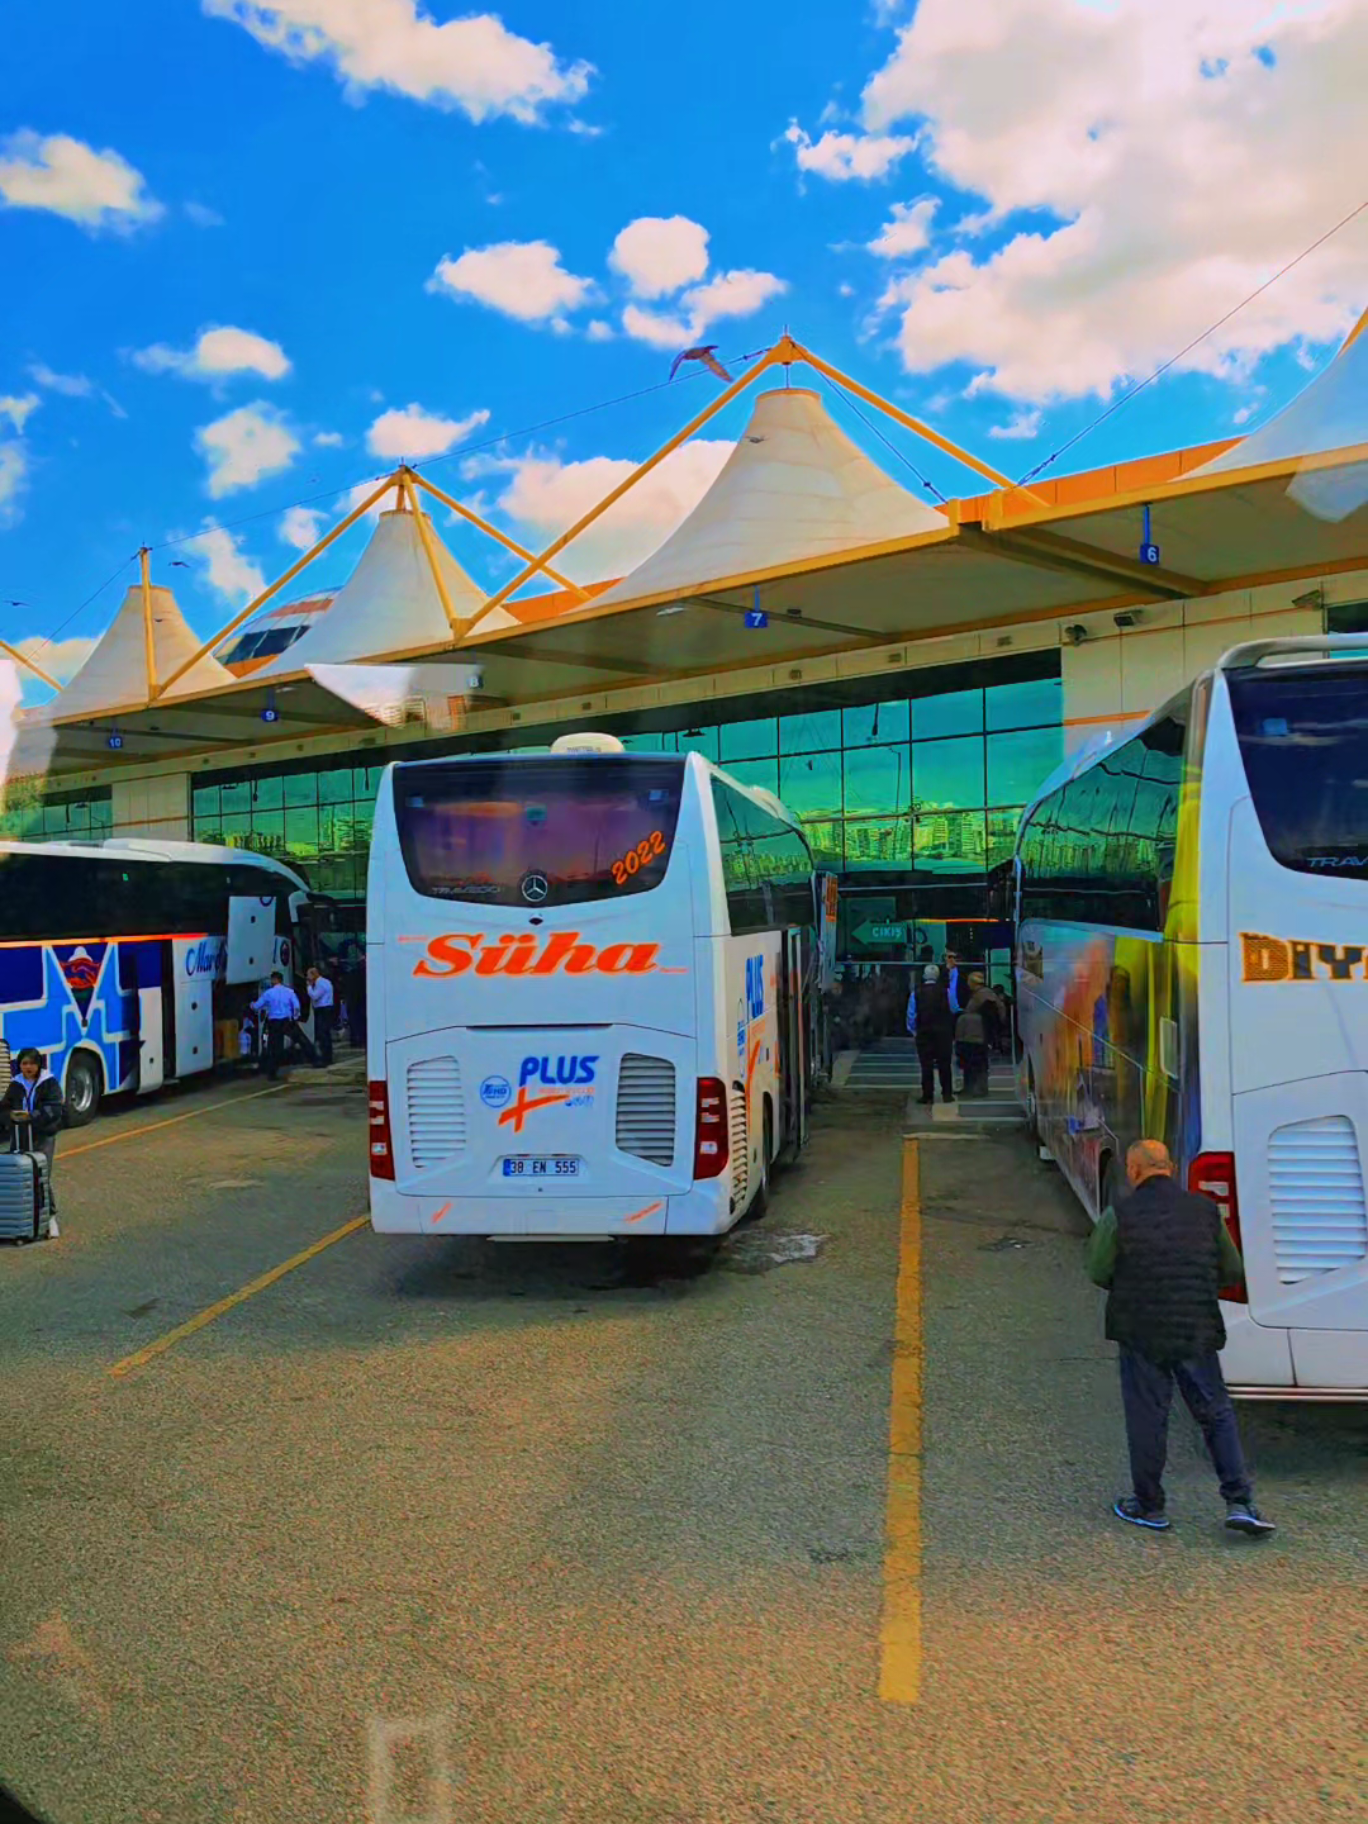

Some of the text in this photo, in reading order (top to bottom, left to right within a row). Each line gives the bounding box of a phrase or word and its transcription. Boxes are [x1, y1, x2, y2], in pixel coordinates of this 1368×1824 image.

[1147, 547, 1157, 562] 6
[751, 612, 762, 626] 7
[265, 710, 275, 721] 9
[110, 737, 121, 747] 10
[612, 831, 666, 884] 2022
[412, 932, 660, 977] Süha
[745, 954, 764, 1024] PLUS
[519, 1055, 600, 1087] PLUS
[532, 1161, 547, 1174] EN
[555, 1161, 576, 1174] 555
